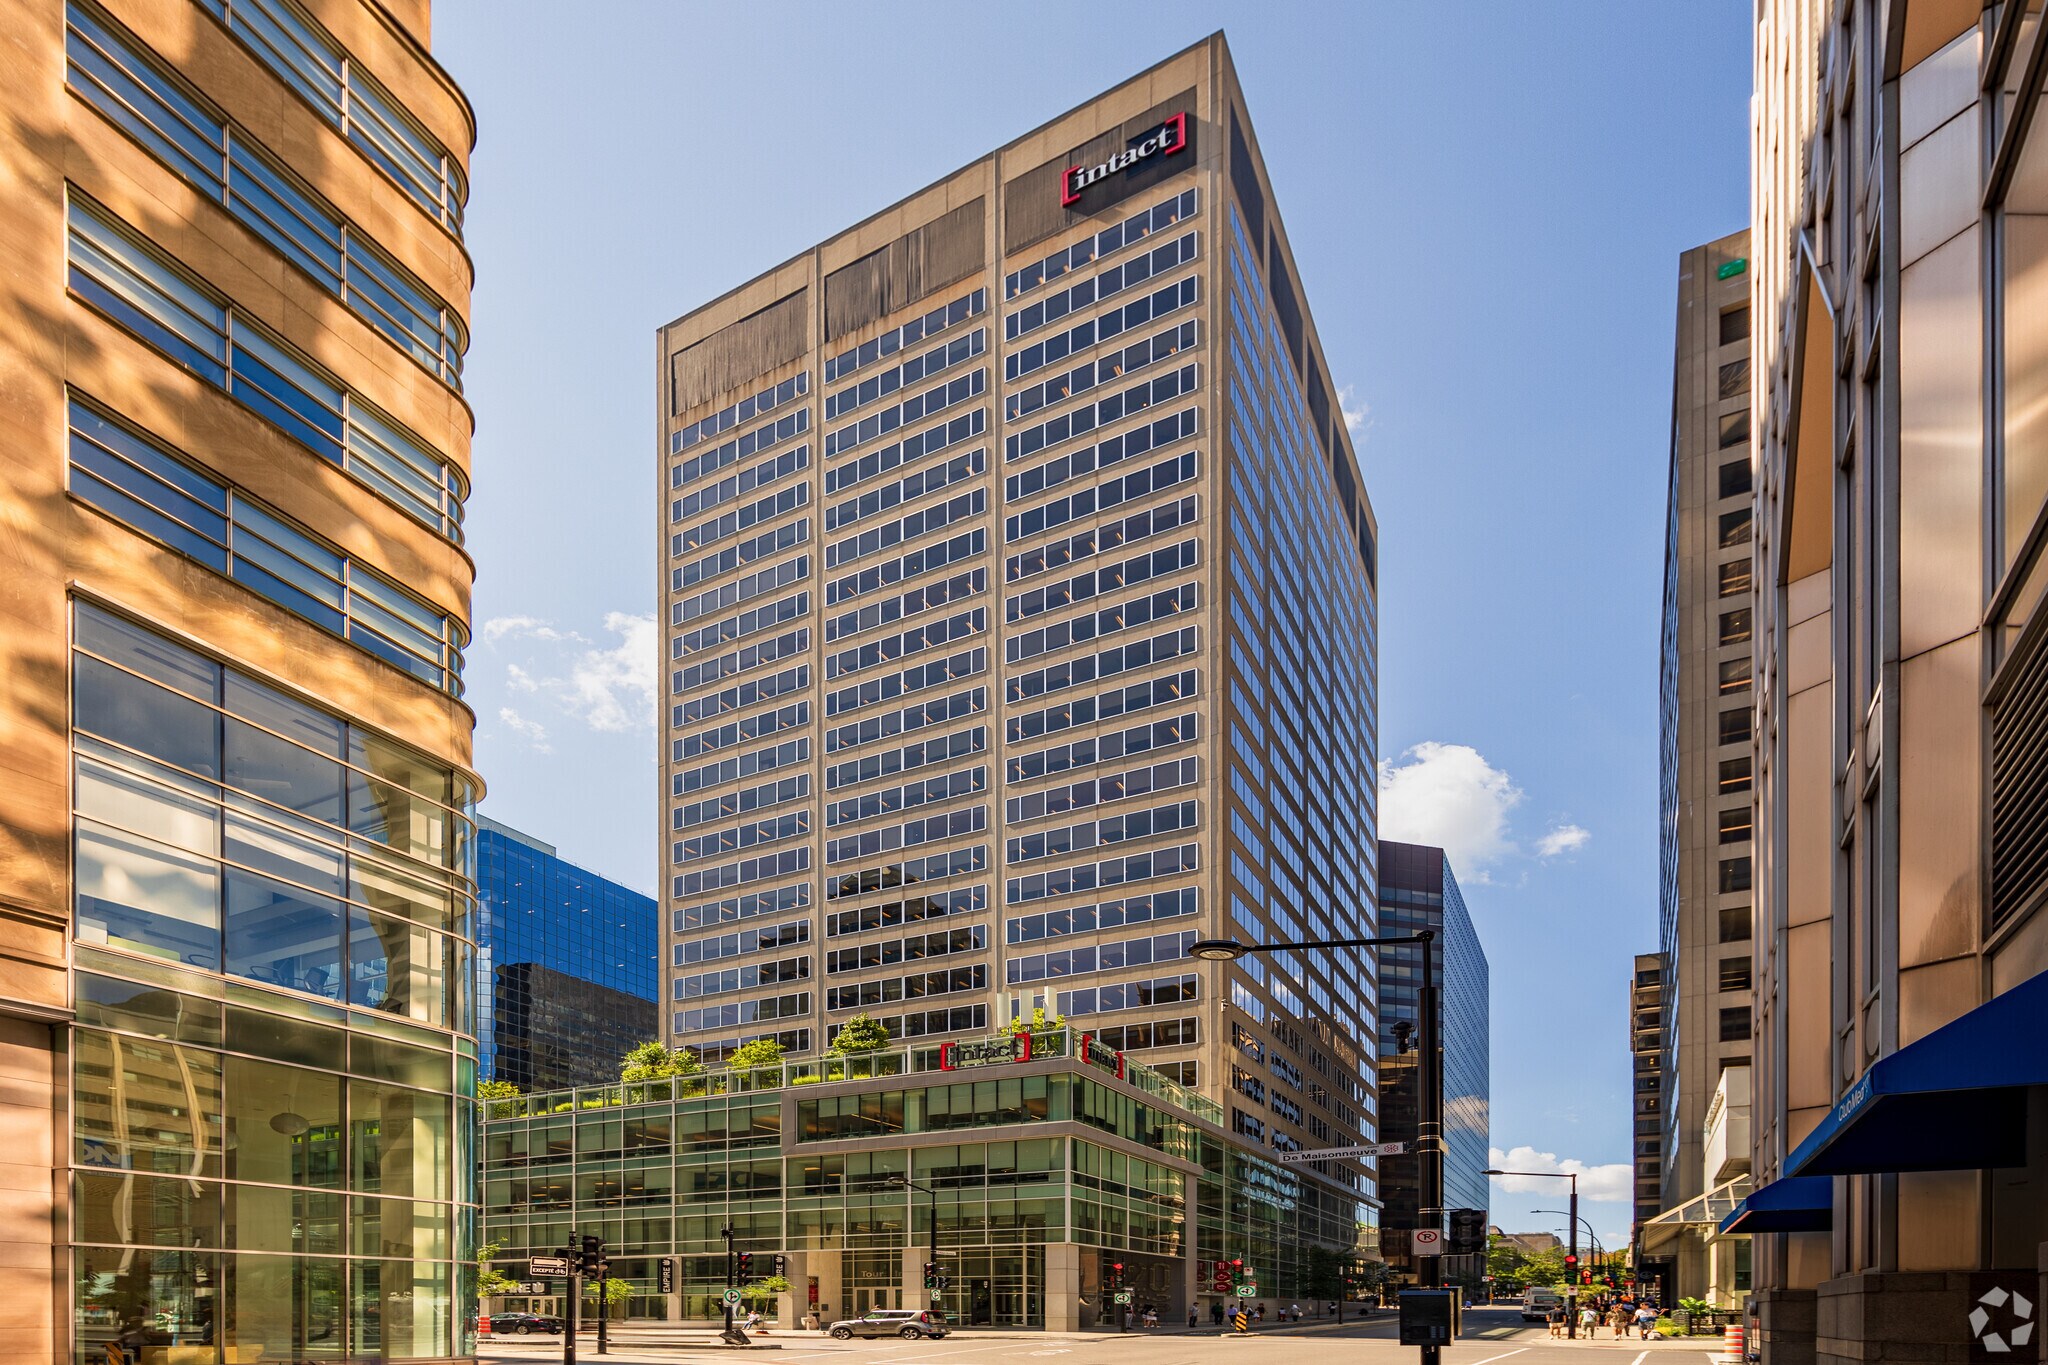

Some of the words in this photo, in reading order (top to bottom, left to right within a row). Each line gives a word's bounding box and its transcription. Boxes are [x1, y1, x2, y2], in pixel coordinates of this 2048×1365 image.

[1301, 1148, 1378, 1160] Maisonneuve
[662, 1266, 671, 1293] EMPIRE
[861, 1270, 884, 1278] Tour
